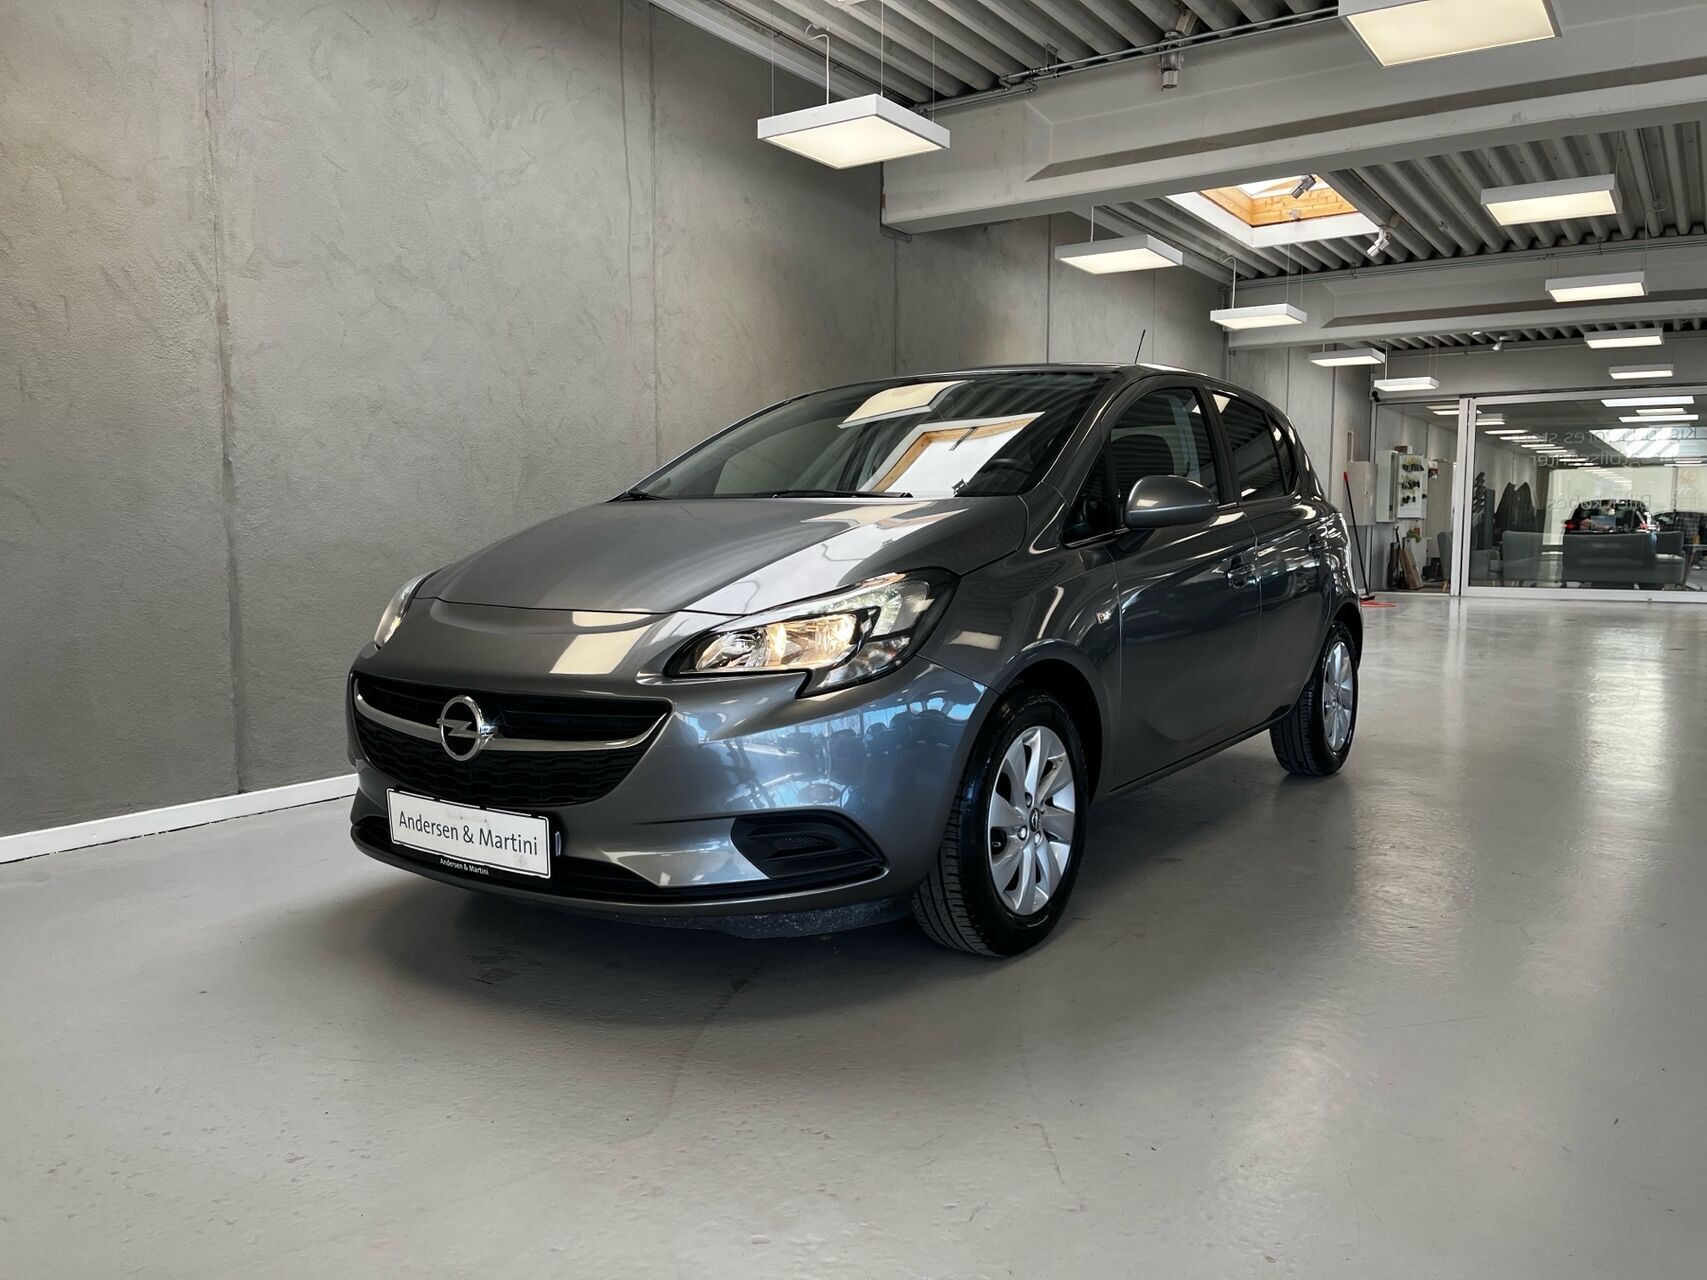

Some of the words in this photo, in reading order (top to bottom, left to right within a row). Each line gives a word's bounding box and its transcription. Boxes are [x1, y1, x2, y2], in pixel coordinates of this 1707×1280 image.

[398, 810, 459, 841] Andersen
[462, 825, 475, 845] &
[479, 827, 538, 856] Martini
[439, 858, 463, 870] Andersen
[469, 865, 490, 876] Martini
